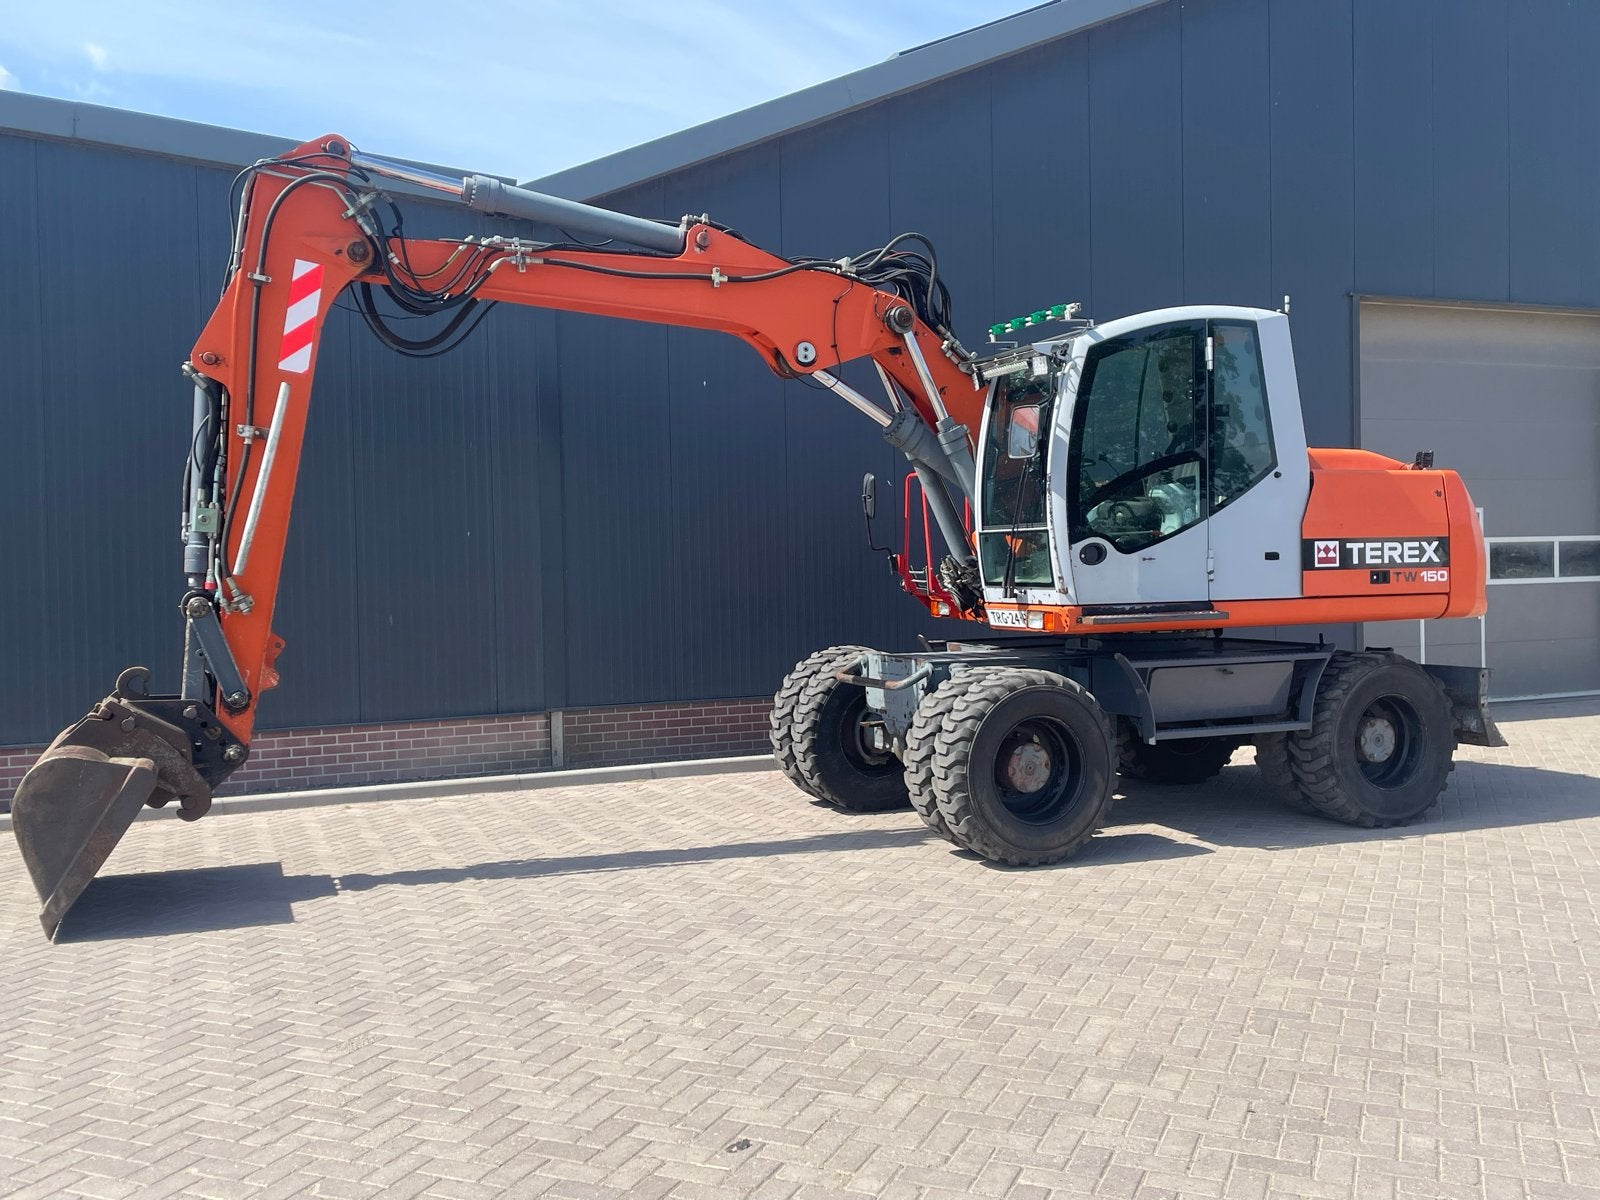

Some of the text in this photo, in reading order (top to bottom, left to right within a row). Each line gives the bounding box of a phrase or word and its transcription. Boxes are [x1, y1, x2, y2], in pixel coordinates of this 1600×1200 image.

[1346, 541, 1440, 564] TEREX
[1394, 570, 1448, 582] TW 150
